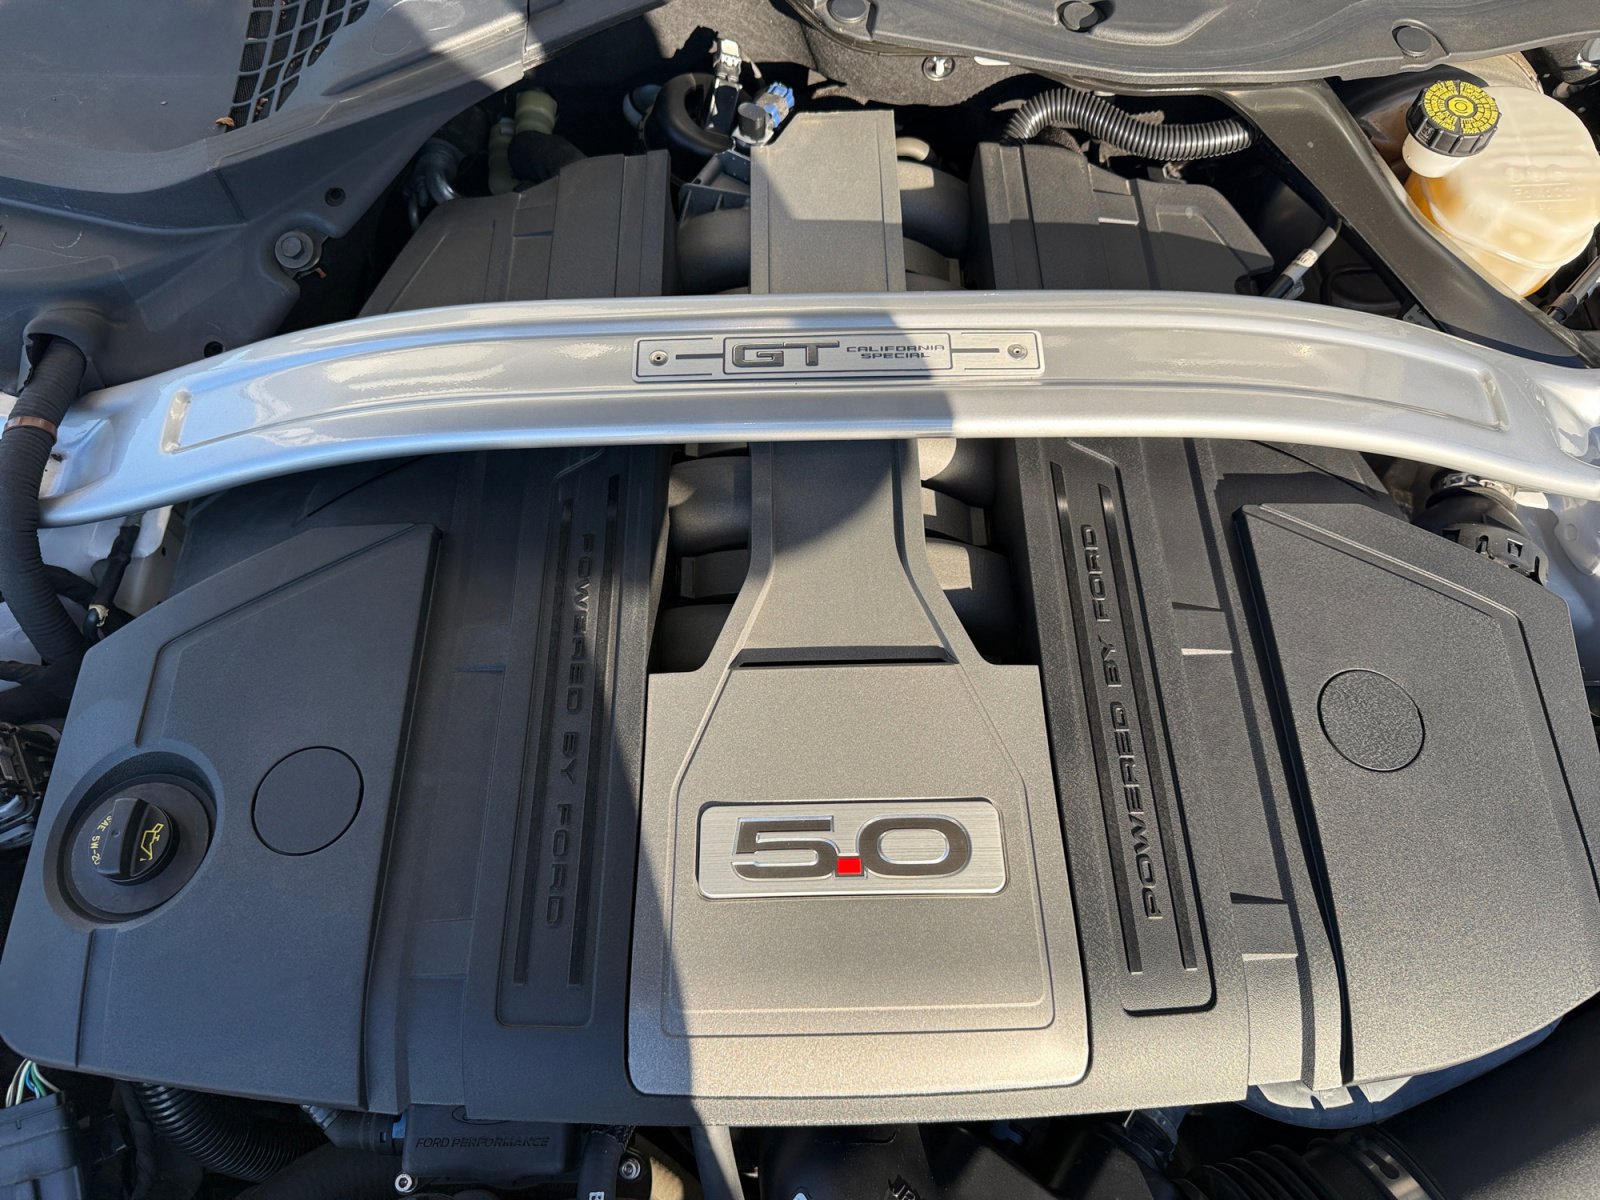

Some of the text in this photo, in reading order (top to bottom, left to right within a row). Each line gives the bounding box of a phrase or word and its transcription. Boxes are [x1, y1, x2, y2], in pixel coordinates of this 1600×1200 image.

[732, 340, 840, 367] GT
[846, 344, 945, 353] CALIFORNIA
[546, 533, 594, 929] POWERED BY FORD
[1080, 523, 1163, 920] POWERED BY FORD
[730, 813, 972, 882] 5.0
[415, 1136, 550, 1149] FORD PERFORMANCE
